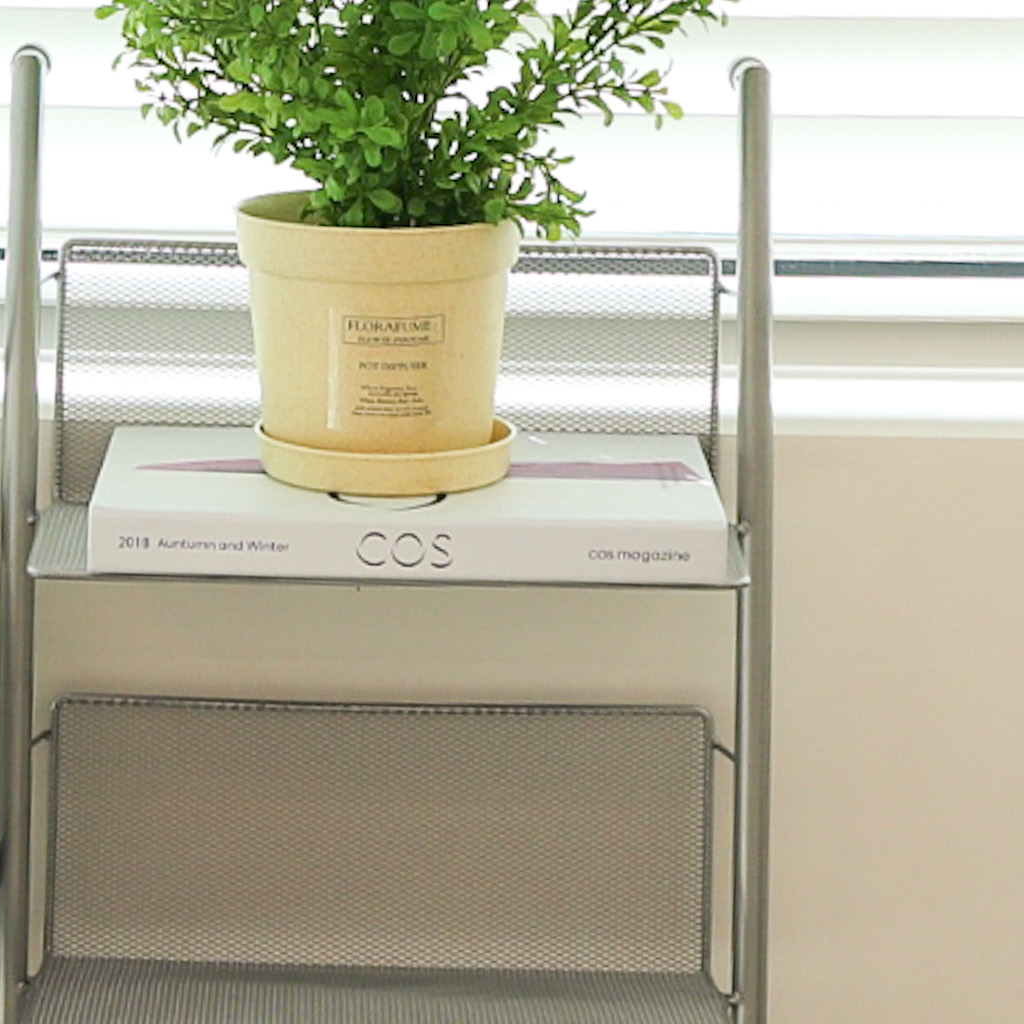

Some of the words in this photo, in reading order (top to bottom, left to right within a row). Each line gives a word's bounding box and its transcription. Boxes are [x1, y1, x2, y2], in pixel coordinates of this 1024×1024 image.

[118, 535, 150, 550] 2018
[218, 540, 244, 551] and
[246, 539, 290, 553] Winter
[356, 531, 454, 569] COS
[588, 549, 615, 561] cos
[617, 549, 692, 563] magazine
